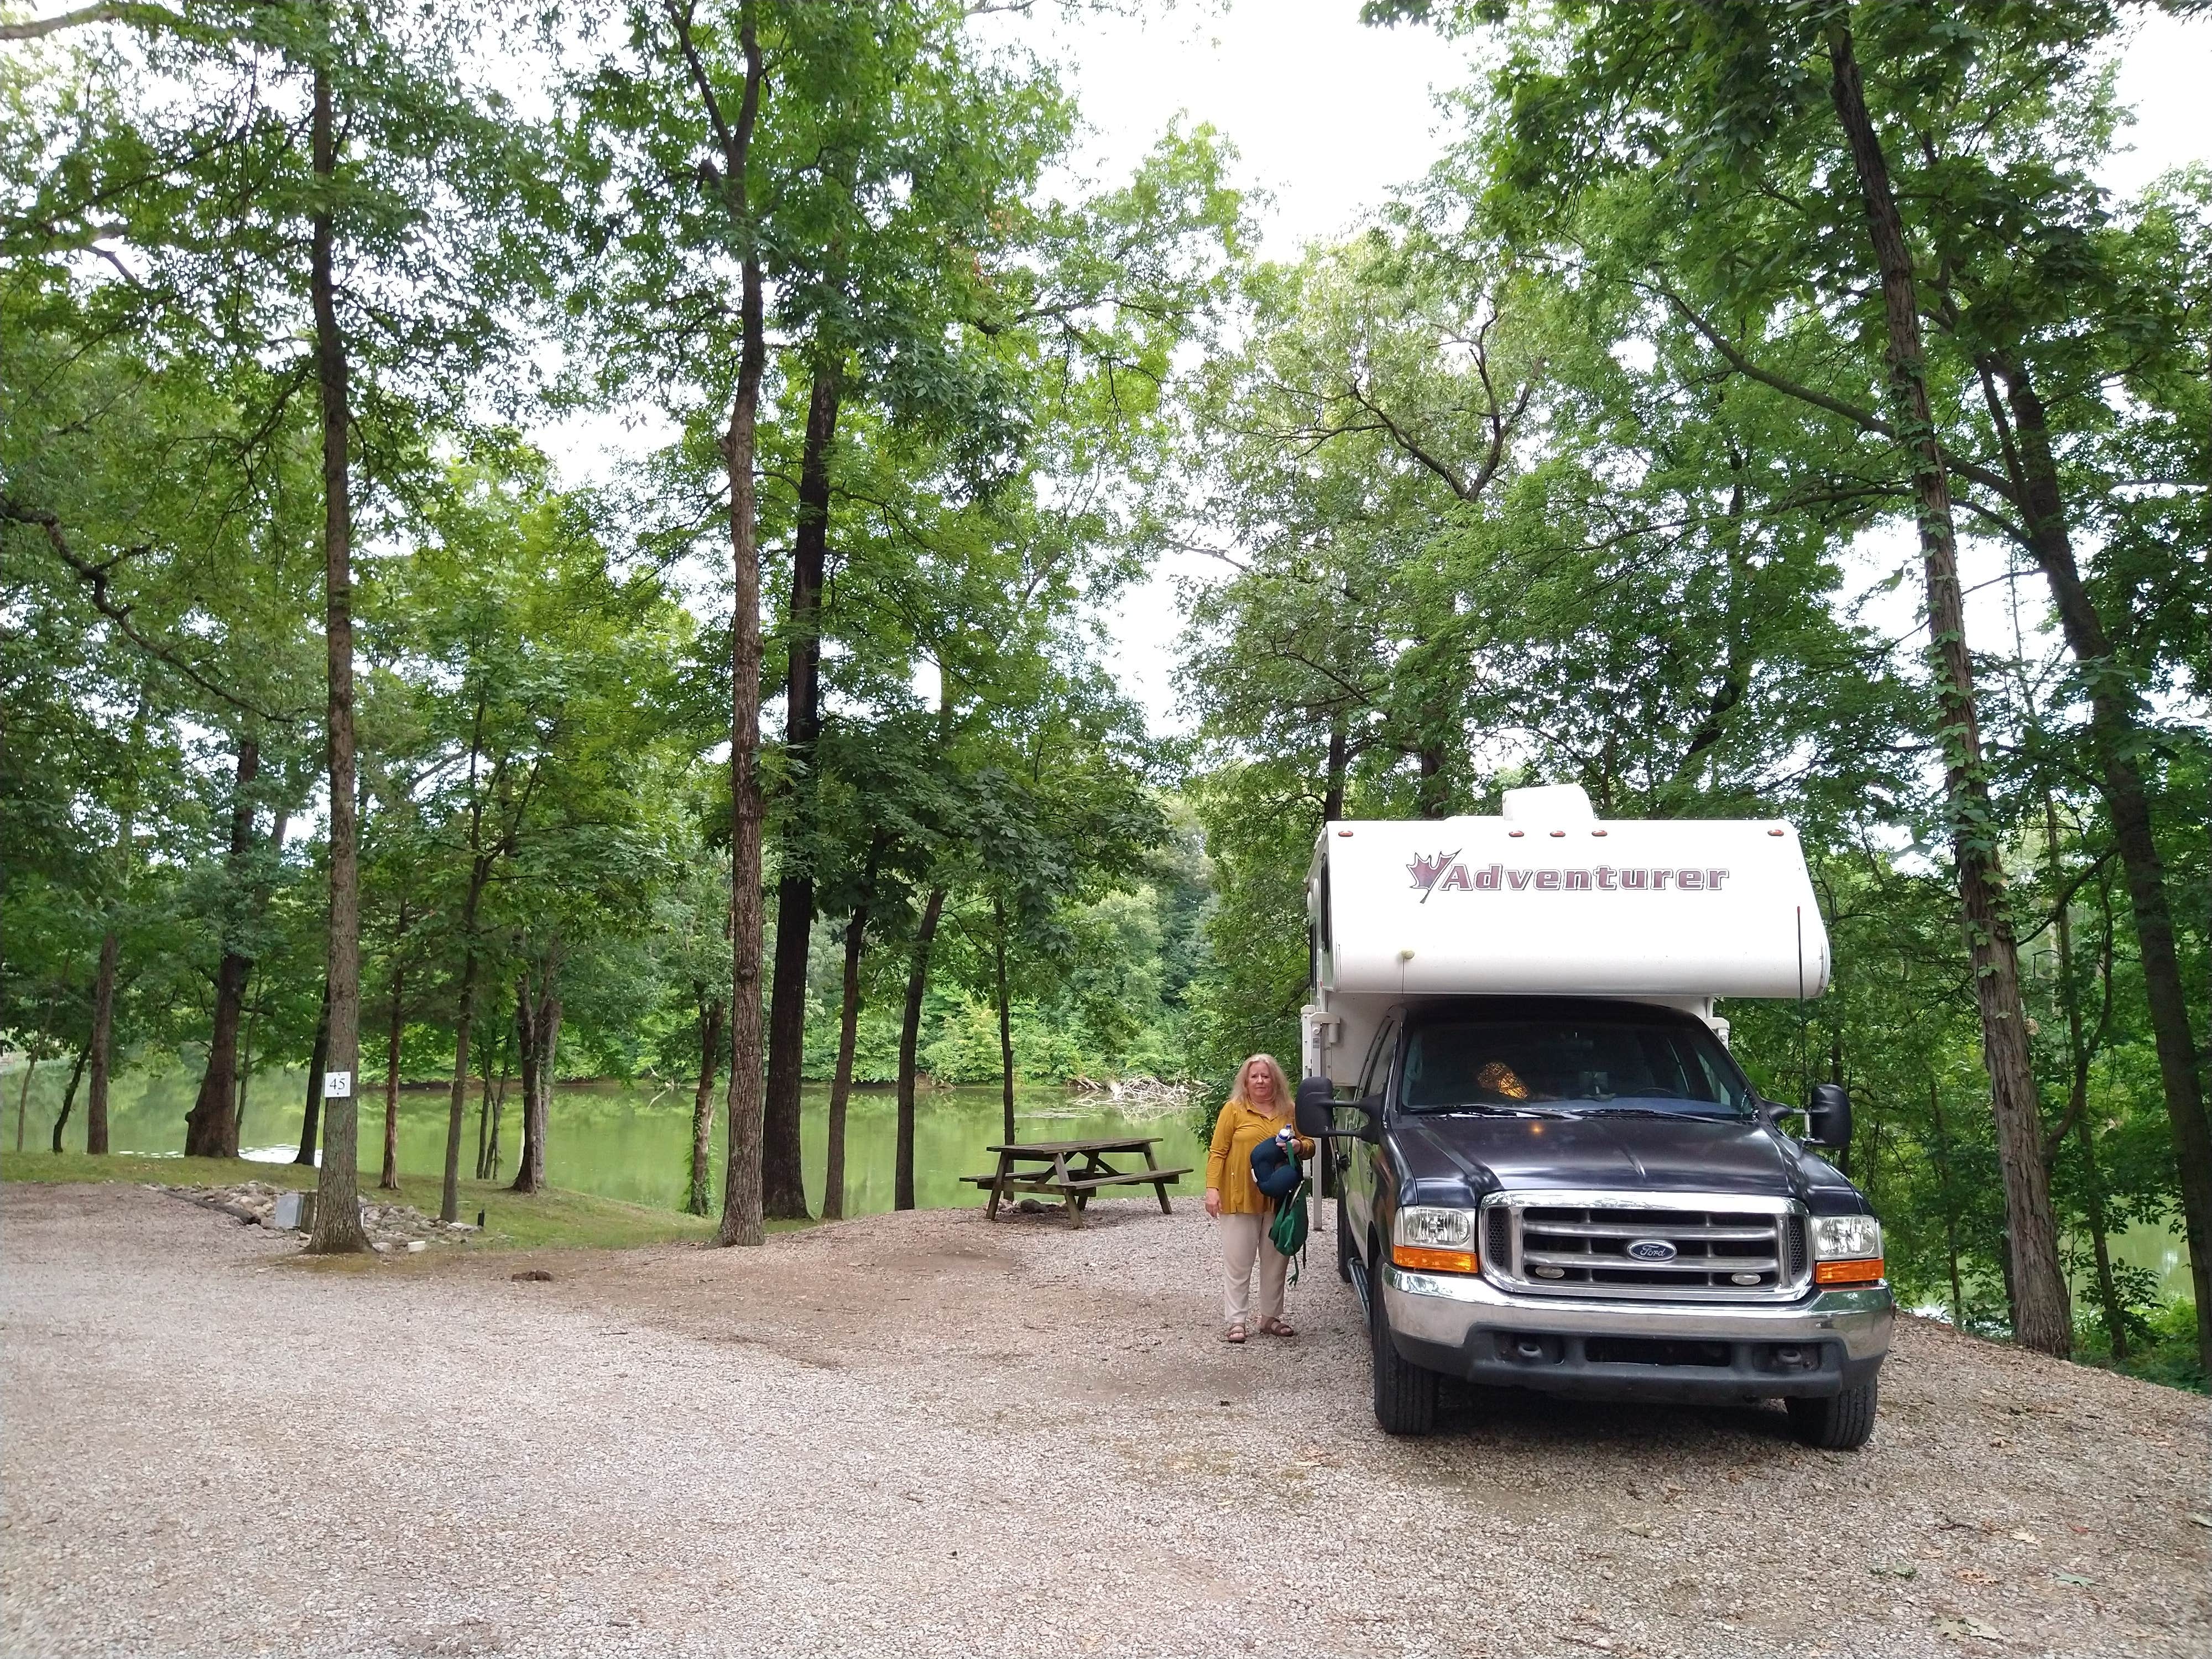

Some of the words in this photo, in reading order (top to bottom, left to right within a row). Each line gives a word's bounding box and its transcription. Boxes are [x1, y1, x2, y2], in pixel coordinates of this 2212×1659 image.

[1439, 864, 1729, 890] Adventurer
[330, 1078, 346, 1090] 45
[1640, 1245, 1666, 1256] Ford
